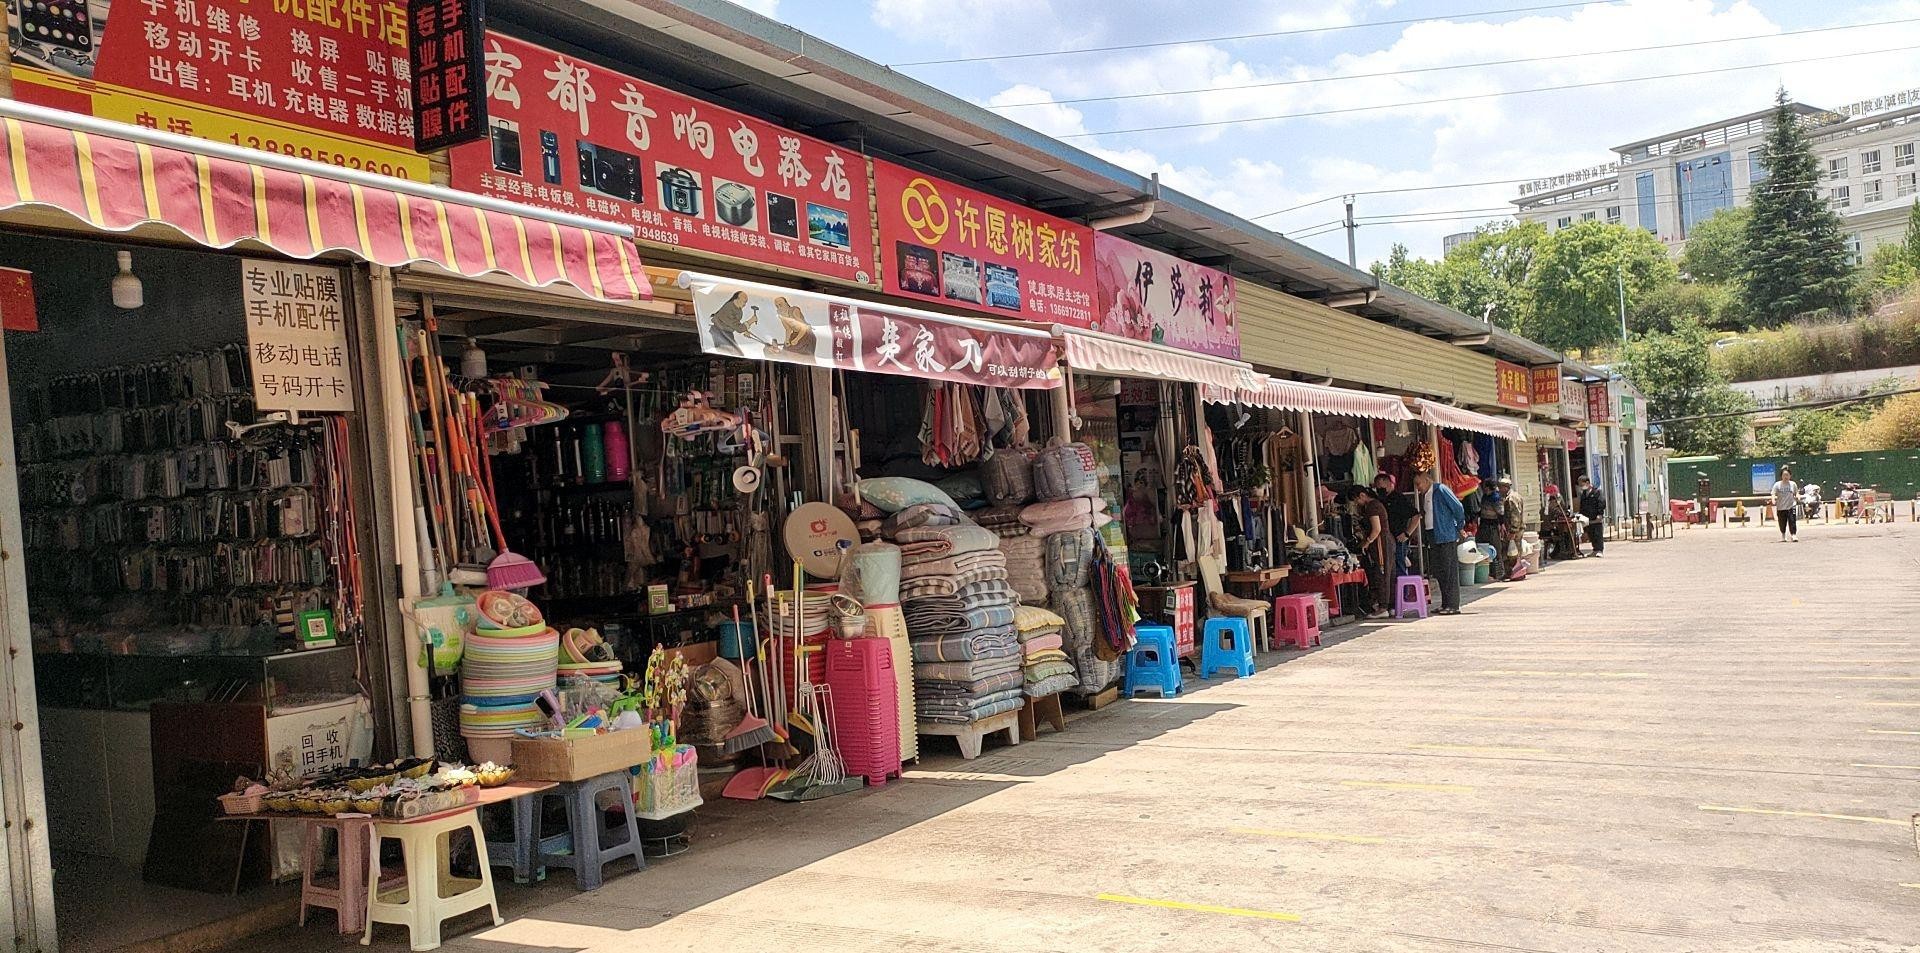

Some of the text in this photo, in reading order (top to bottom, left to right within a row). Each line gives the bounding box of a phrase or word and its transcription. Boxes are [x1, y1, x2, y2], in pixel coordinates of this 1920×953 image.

[143, 20, 413, 111] 移动开卡 收售二手机
[290, 28, 340, 63] 换屏
[366, 50, 412, 83] 贴膜
[416, 5, 443, 139] 专业贴膜
[227, 73, 276, 108] 耳机
[282, 87, 349, 124] 充电器
[355, 103, 415, 139] 数据线
[484, 39, 852, 201] 宏都音响电器店
[954, 199, 1082, 276] 许愿树家纺
[246, 267, 338, 302] 专业贴膜
[1028, 280, 1090, 307] 健康家居生活馆
[1134, 258, 1215, 327] 伊莎莉
[249, 301, 341, 332] 手机配件
[254, 341, 342, 368] 移动电话
[876, 316, 984, 373] 楚家刀
[987, 363, 1046, 380] 可以刮胡子的
[259, 374, 346, 398] 号码开卡
[302, 745, 343, 766] 旧手机
